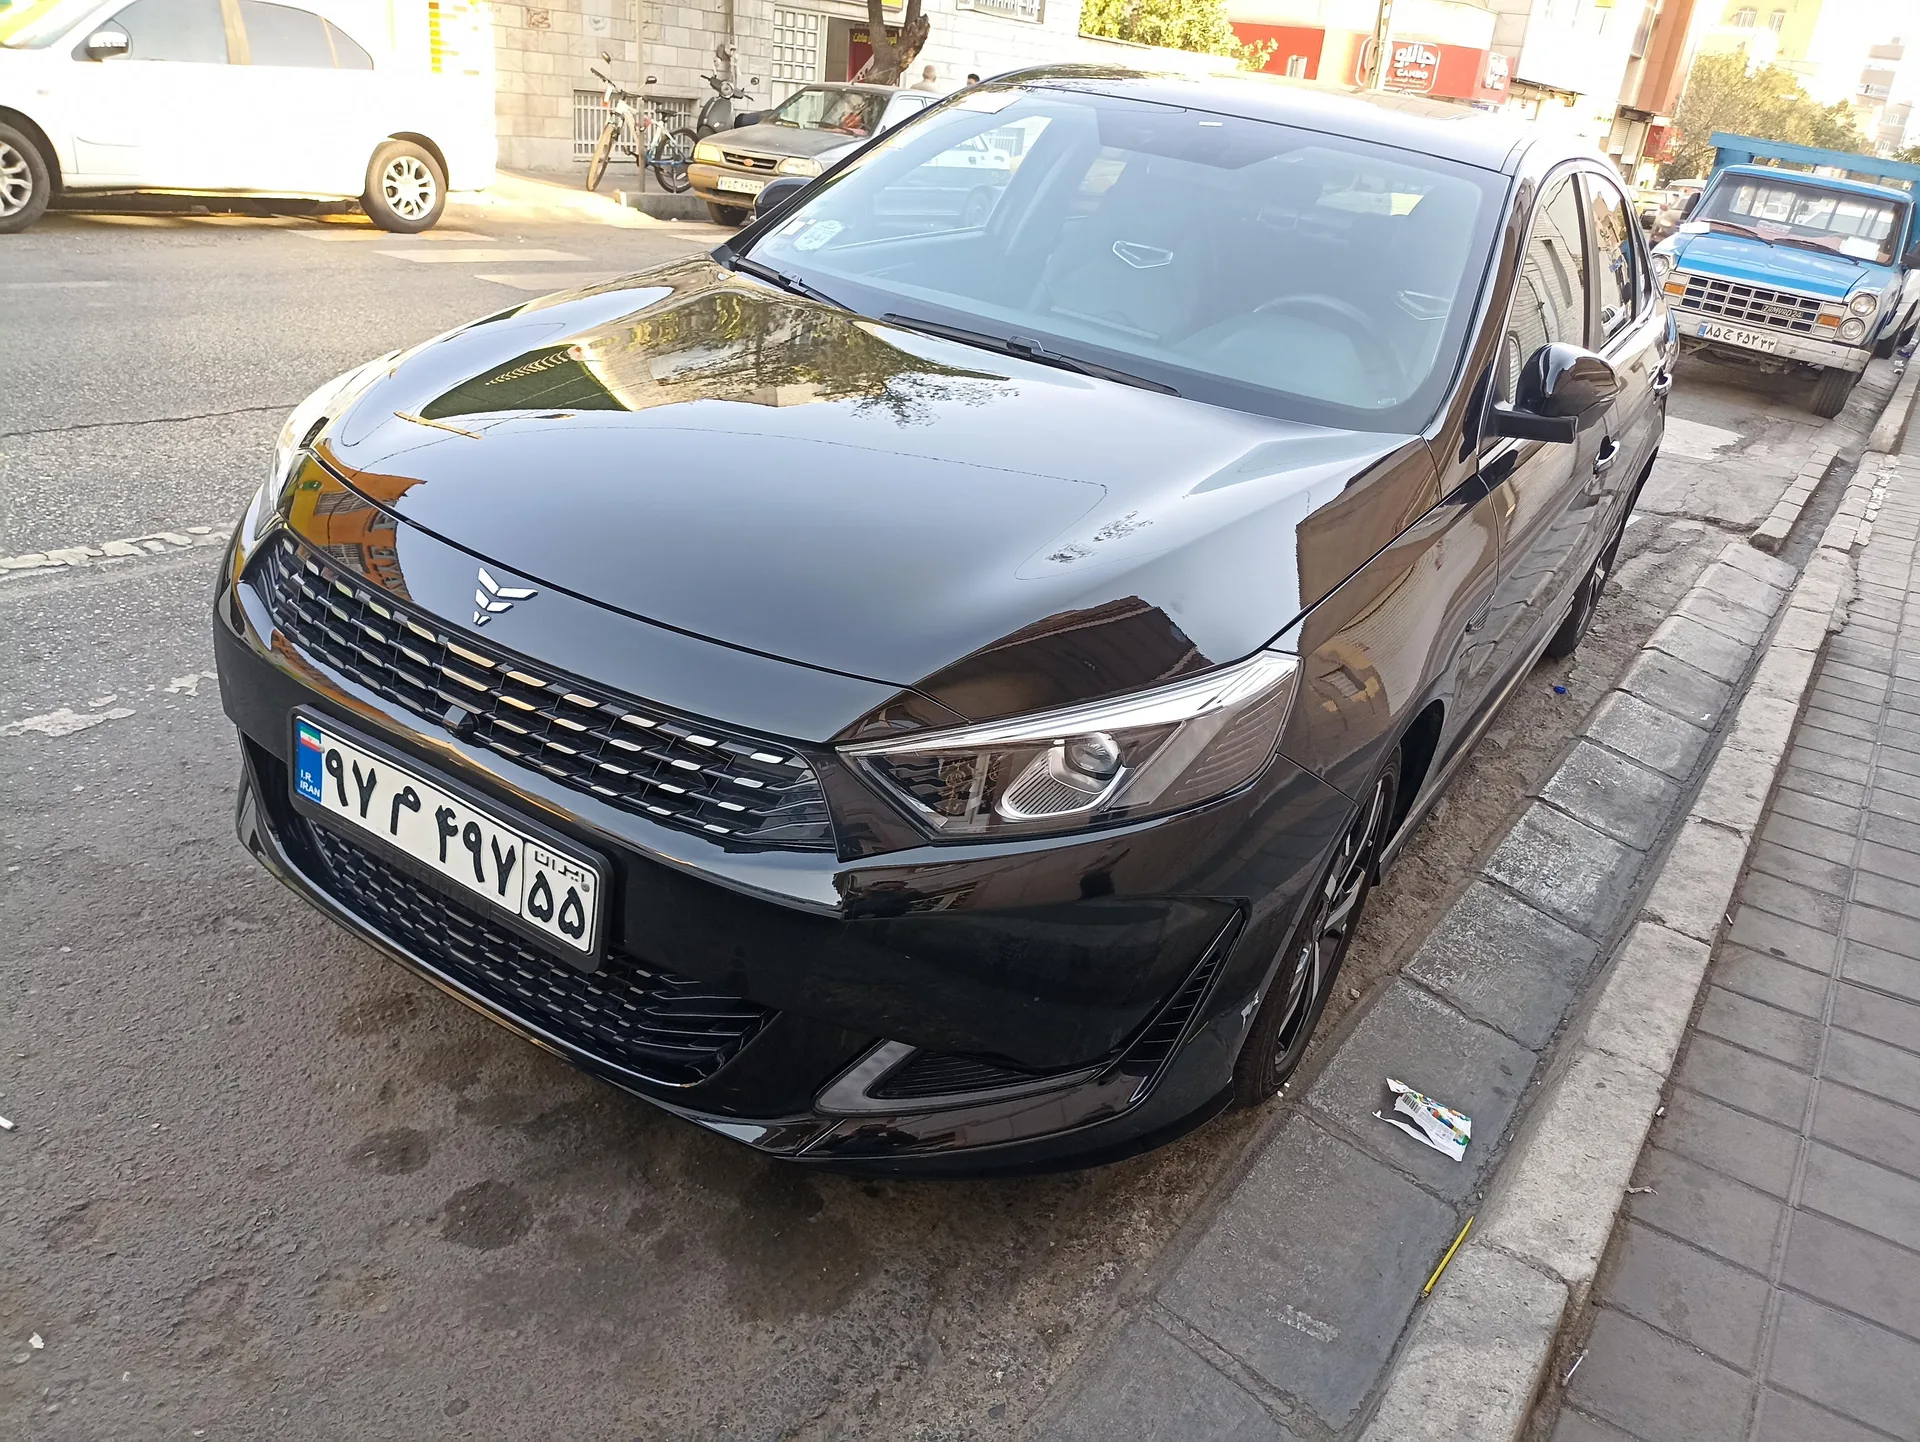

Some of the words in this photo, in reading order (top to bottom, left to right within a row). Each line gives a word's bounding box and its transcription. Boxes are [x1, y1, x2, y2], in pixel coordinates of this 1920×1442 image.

[300, 769, 313, 784] I.R.
[300, 781, 321, 799] IRAN
[325, 748, 377, 819] ۹۷
[390, 785, 421, 836] م
[435, 804, 516, 897] ۴۹۷
[534, 850, 585, 883] ایران
[527, 869, 586, 940] ۵۵
